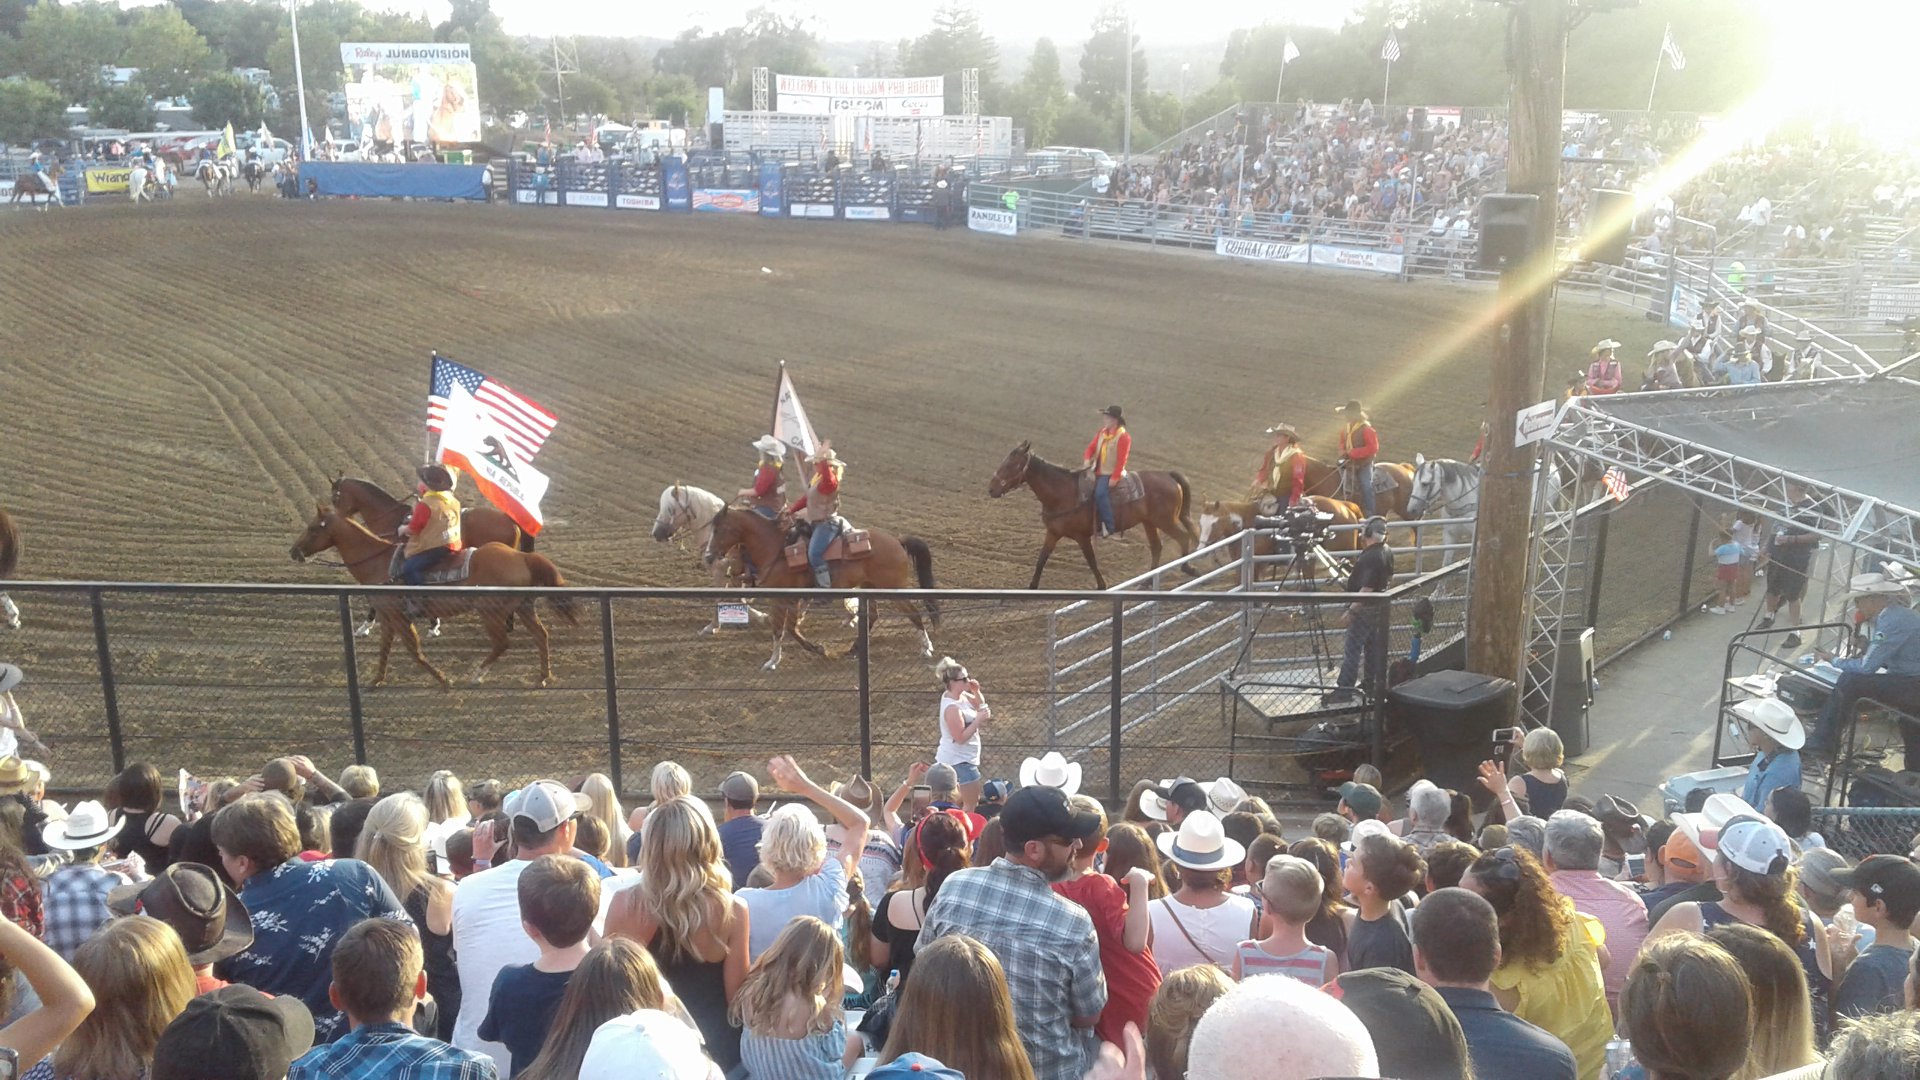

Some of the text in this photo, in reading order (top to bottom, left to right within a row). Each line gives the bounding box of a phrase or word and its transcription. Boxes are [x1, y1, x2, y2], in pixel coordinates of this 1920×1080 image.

[385, 49, 469, 59] JUMBOVISION
[780, 78, 817, 93] WELCOME
[821, 79, 831, 94] TO
[834, 79, 849, 95] THE
[852, 79, 885, 95] FOLSOM
[834, 100, 884, 111] FOLSOM
[92, 171, 132, 185] Wrang
[622, 198, 654, 206] TOSHIBA
[1225, 240, 1292, 259] CORRAL CLUB
